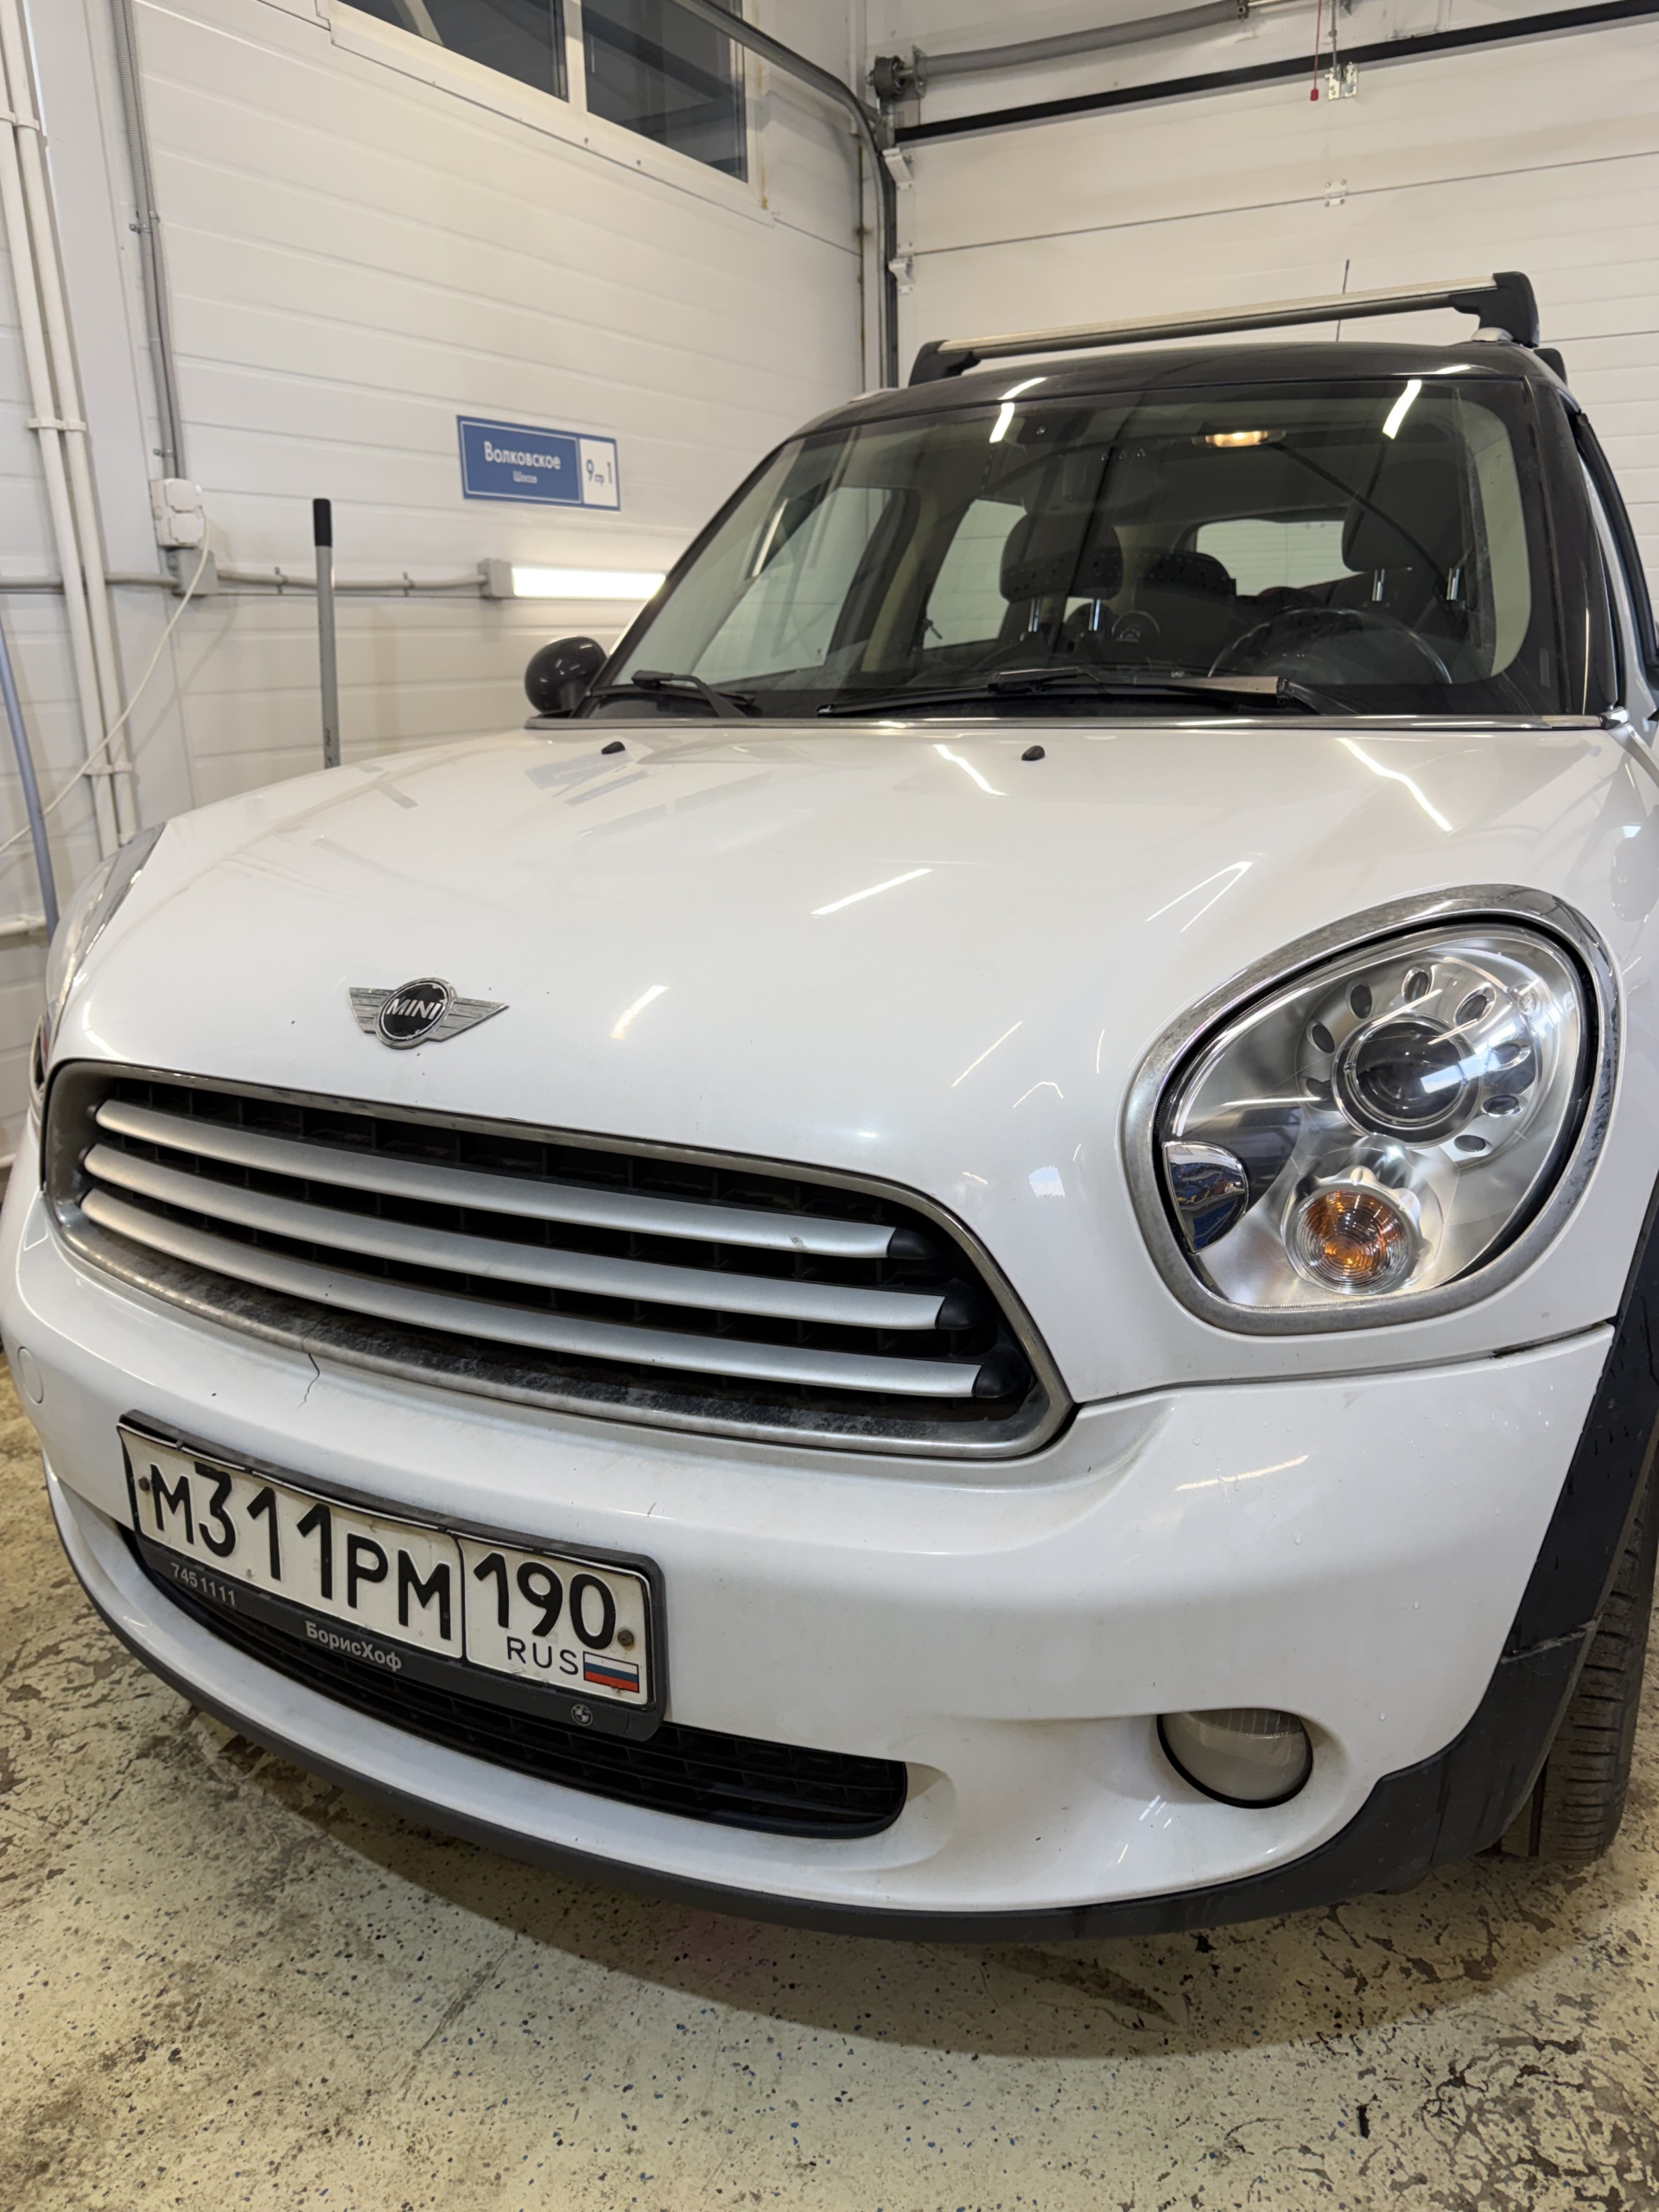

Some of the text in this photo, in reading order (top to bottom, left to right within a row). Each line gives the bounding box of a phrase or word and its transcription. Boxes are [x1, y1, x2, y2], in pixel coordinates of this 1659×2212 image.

[484, 441, 562, 470] Волковское
[387, 998, 442, 1020] MINI
[474, 1552, 616, 1650] 190
[305, 1620, 402, 1672] БорисХоф
[506, 1636, 579, 1675] RUS
